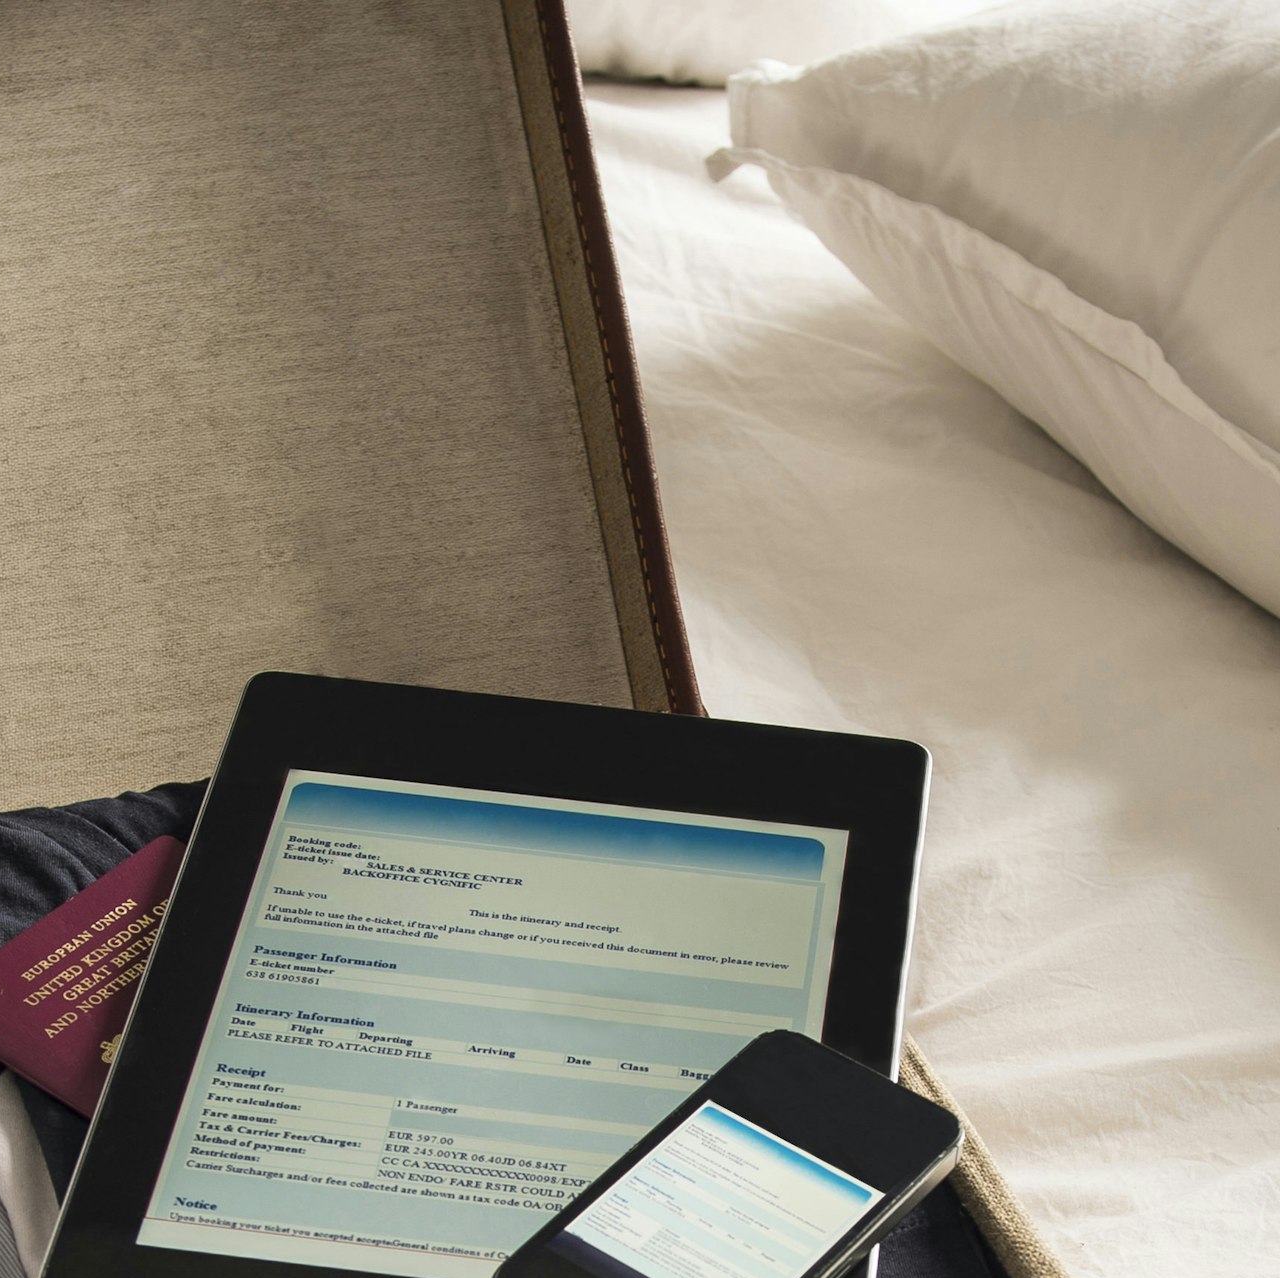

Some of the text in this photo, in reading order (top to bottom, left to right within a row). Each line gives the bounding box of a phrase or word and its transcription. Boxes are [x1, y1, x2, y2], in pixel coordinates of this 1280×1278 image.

[283, 842, 381, 861] E-ticket issue date:
[286, 834, 362, 850] Booking code:
[281, 851, 335, 865] Issued by:
[341, 866, 483, 890] BACKOFFICE CYGNIFIC
[365, 860, 523, 886] SALES & SERVICE CENTER
[272, 885, 327, 900] Thank you
[263, 911, 439, 940] full information in the attached file
[468, 908, 622, 934] This is the itinerary and receipt.
[20, 898, 138, 982] EUROPEAN UNION
[265, 903, 790, 970] If unable to use the e-ticket, if travel plans change or if you received this document in error, please review
[23, 965, 83, 1007] UNITED
[80, 914, 156, 967] KINGDOM
[248, 957, 335, 975] E-ticket number
[251, 944, 397, 970] Passenger Information
[62, 964, 113, 1001] GREAT
[229, 1016, 256, 1027] Date
[233, 1002, 375, 1028] Itinerary Information
[44, 1011, 78, 1039] AND
[289, 1022, 324, 1035] Flight
[226, 1027, 432, 1060] PLEASE REFER TO ATTACHED FILE
[357, 1030, 413, 1047] Departing
[466, 1044, 516, 1059] Arriving
[565, 1055, 592, 1066] Date
[214, 1062, 267, 1078] Receipt
[619, 1061, 649, 1073] Class
[679, 1068, 712, 1081] Bagg
[210, 1076, 285, 1094] Payment for:
[205, 1091, 302, 1111] Fare calculation:
[404, 1099, 458, 1115] Passenger
[200, 1107, 278, 1125] Fare amount:
[192, 1132, 307, 1155] Method of payment:
[198, 1120, 362, 1148] Tax & Carrier Fees/Charges:
[386, 1129, 454, 1146] EUR 597.00
[188, 1145, 261, 1162] Restrictions:
[380, 1155, 421, 1169] CC CA
[383, 1142, 410, 1154] EUR
[411, 1145, 468, 1161] 245.00YR
[469, 1152, 517, 1166] 06.40JD
[185, 1158, 224, 1171] Carrier
[224, 1163, 284, 1180] Surcharges
[324, 1175, 347, 1186] fees
[348, 1180, 399, 1193] collected
[399, 1186, 418, 1195] are
[419, 1187, 456, 1200] shown
[457, 1193, 470, 1201] as
[471, 1194, 491, 1204] tax
[492, 1197, 520, 1207] code
[376, 1168, 406, 1180] NON
[448, 1176, 483, 1189] FARE
[483, 1180, 518, 1194] RSTR
[519, 1185, 565, 1199] COULD
[172, 1195, 218, 1211] Notice
[168, 1211, 196, 1222] Upon
[197, 1214, 238, 1228] booking
[237, 1221, 262, 1230] your
[263, 1224, 291, 1234] ticket
[291, 1228, 311, 1236] you
[312, 1231, 354, 1242] accepted
